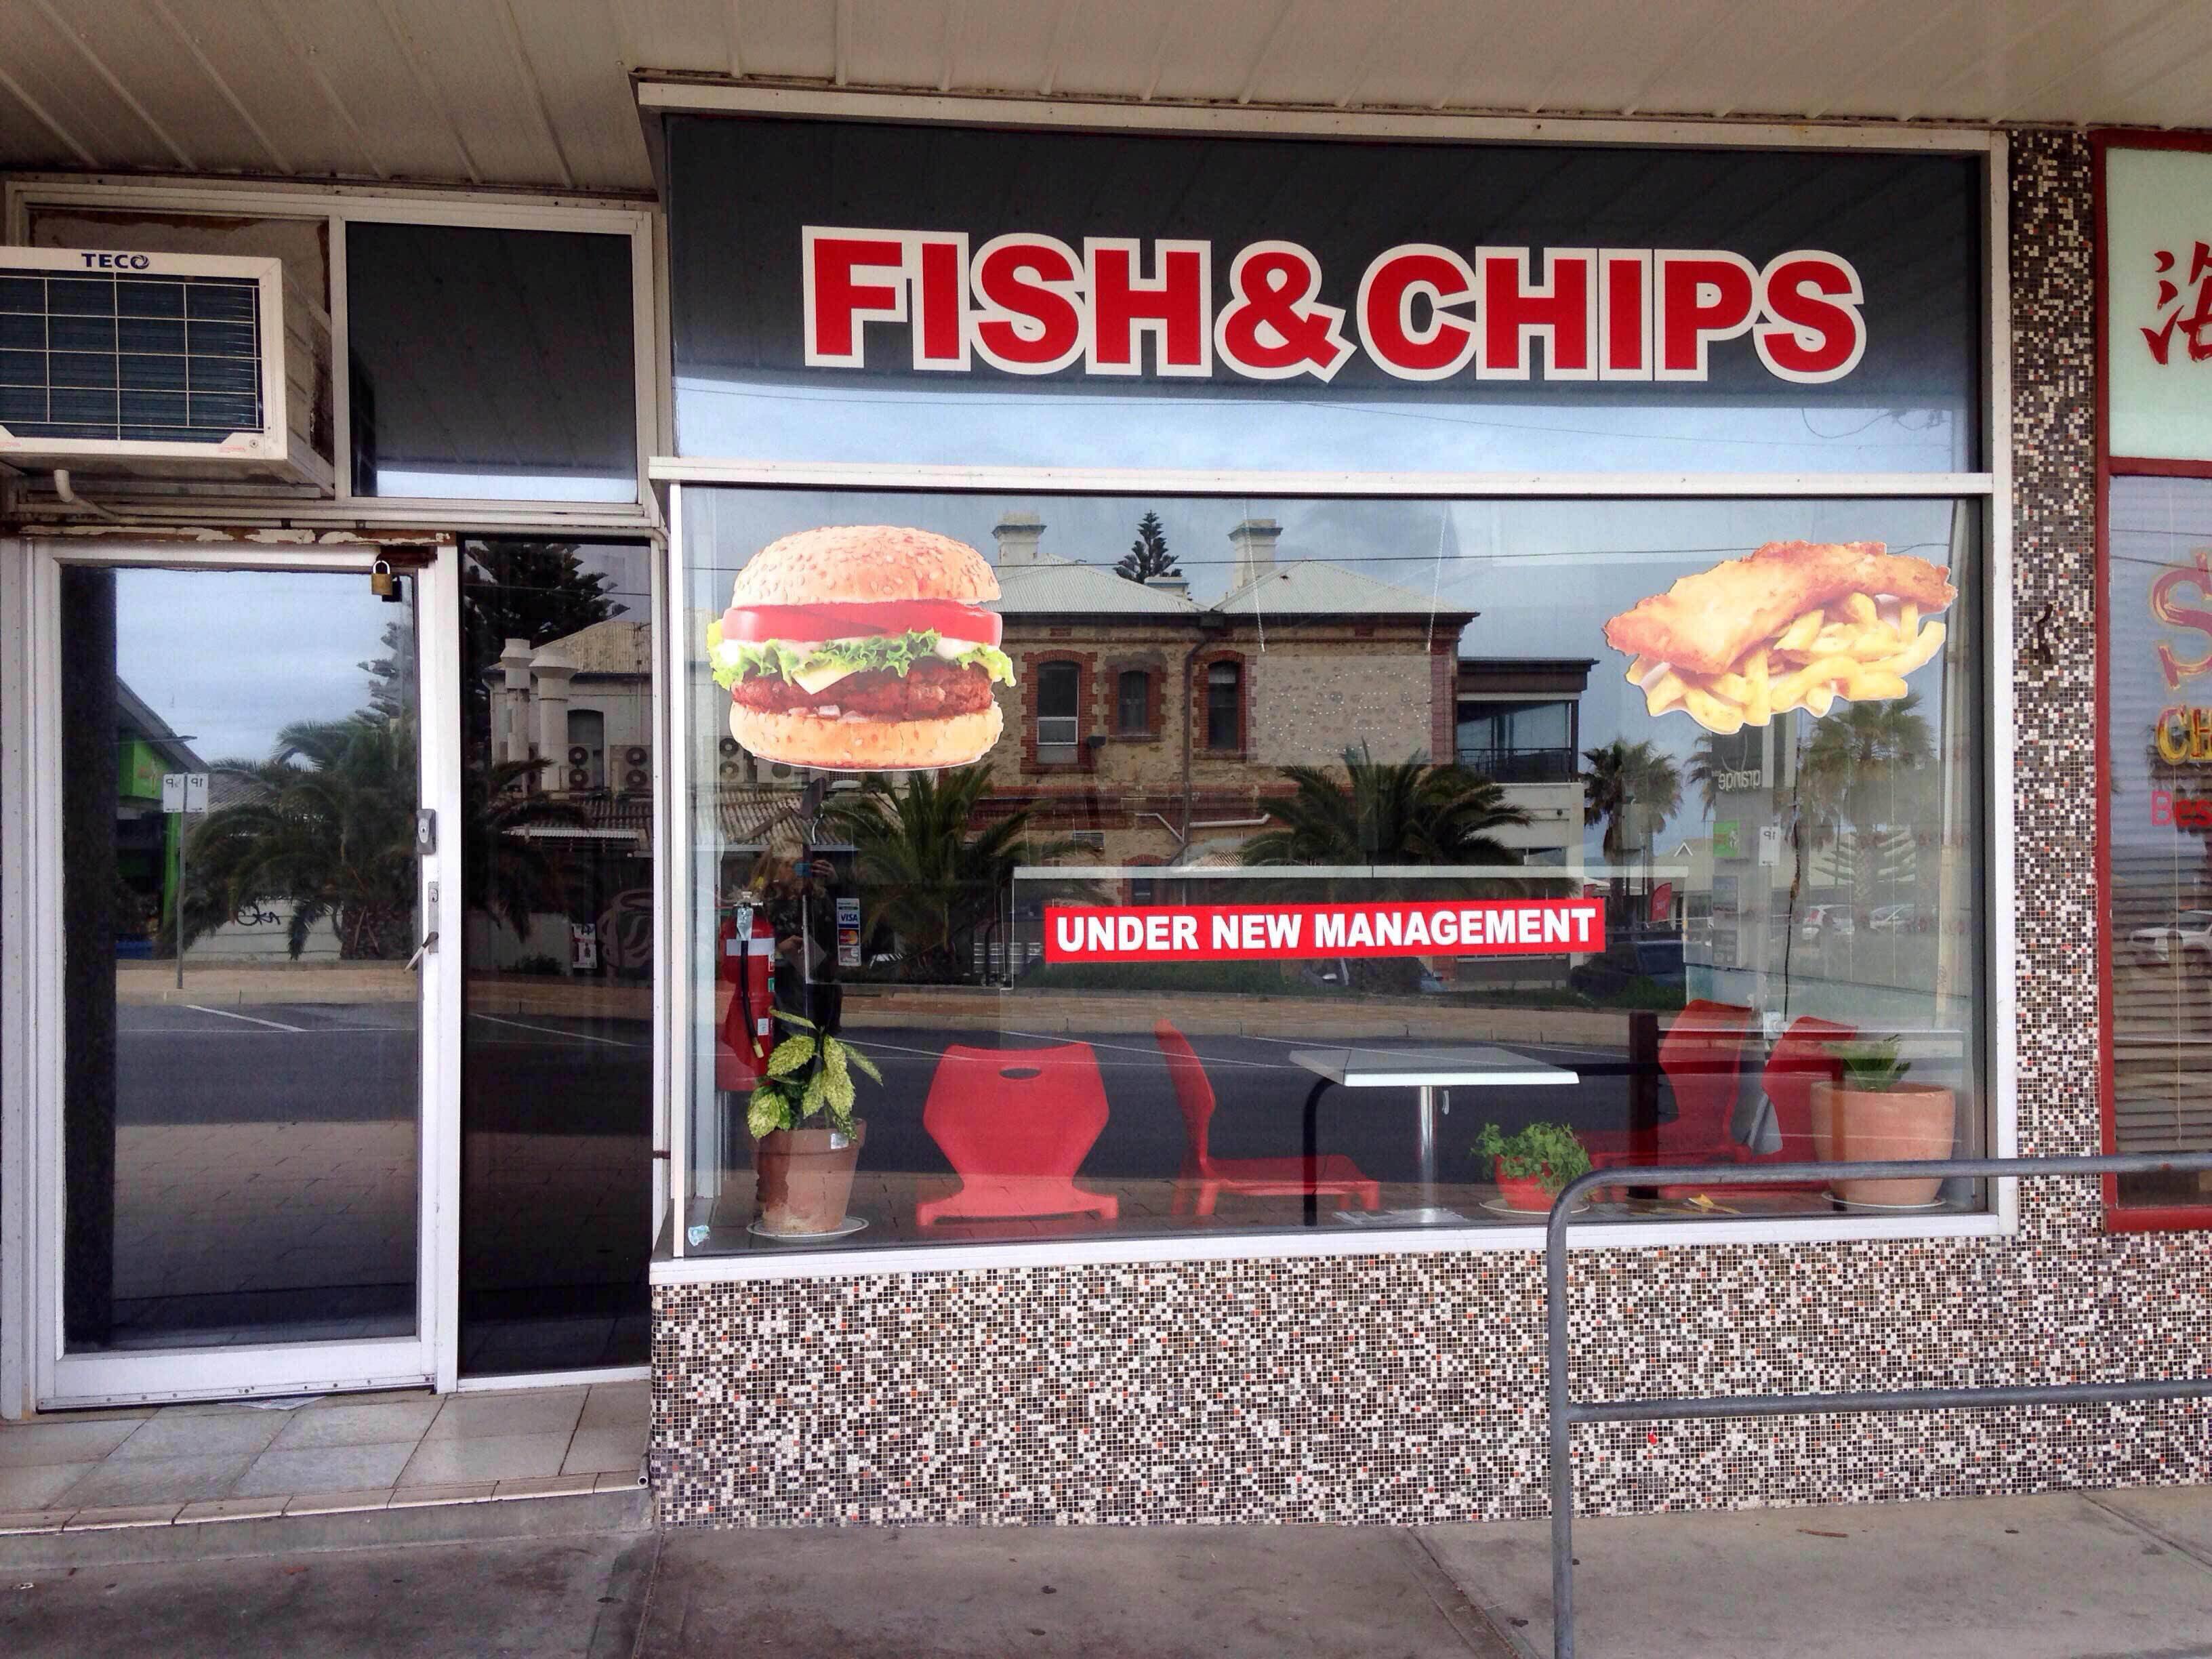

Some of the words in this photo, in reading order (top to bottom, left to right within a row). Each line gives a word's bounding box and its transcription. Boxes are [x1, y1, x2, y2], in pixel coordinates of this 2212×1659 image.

[81, 253, 150, 269] TECO
[1265, 691, 1431, 731] OPEN
[841, 913, 858, 922] VISA
[1057, 915, 1200, 952] UNDER
[1212, 913, 1302, 949] NEW
[1315, 907, 1596, 948] MANAGEMENT
